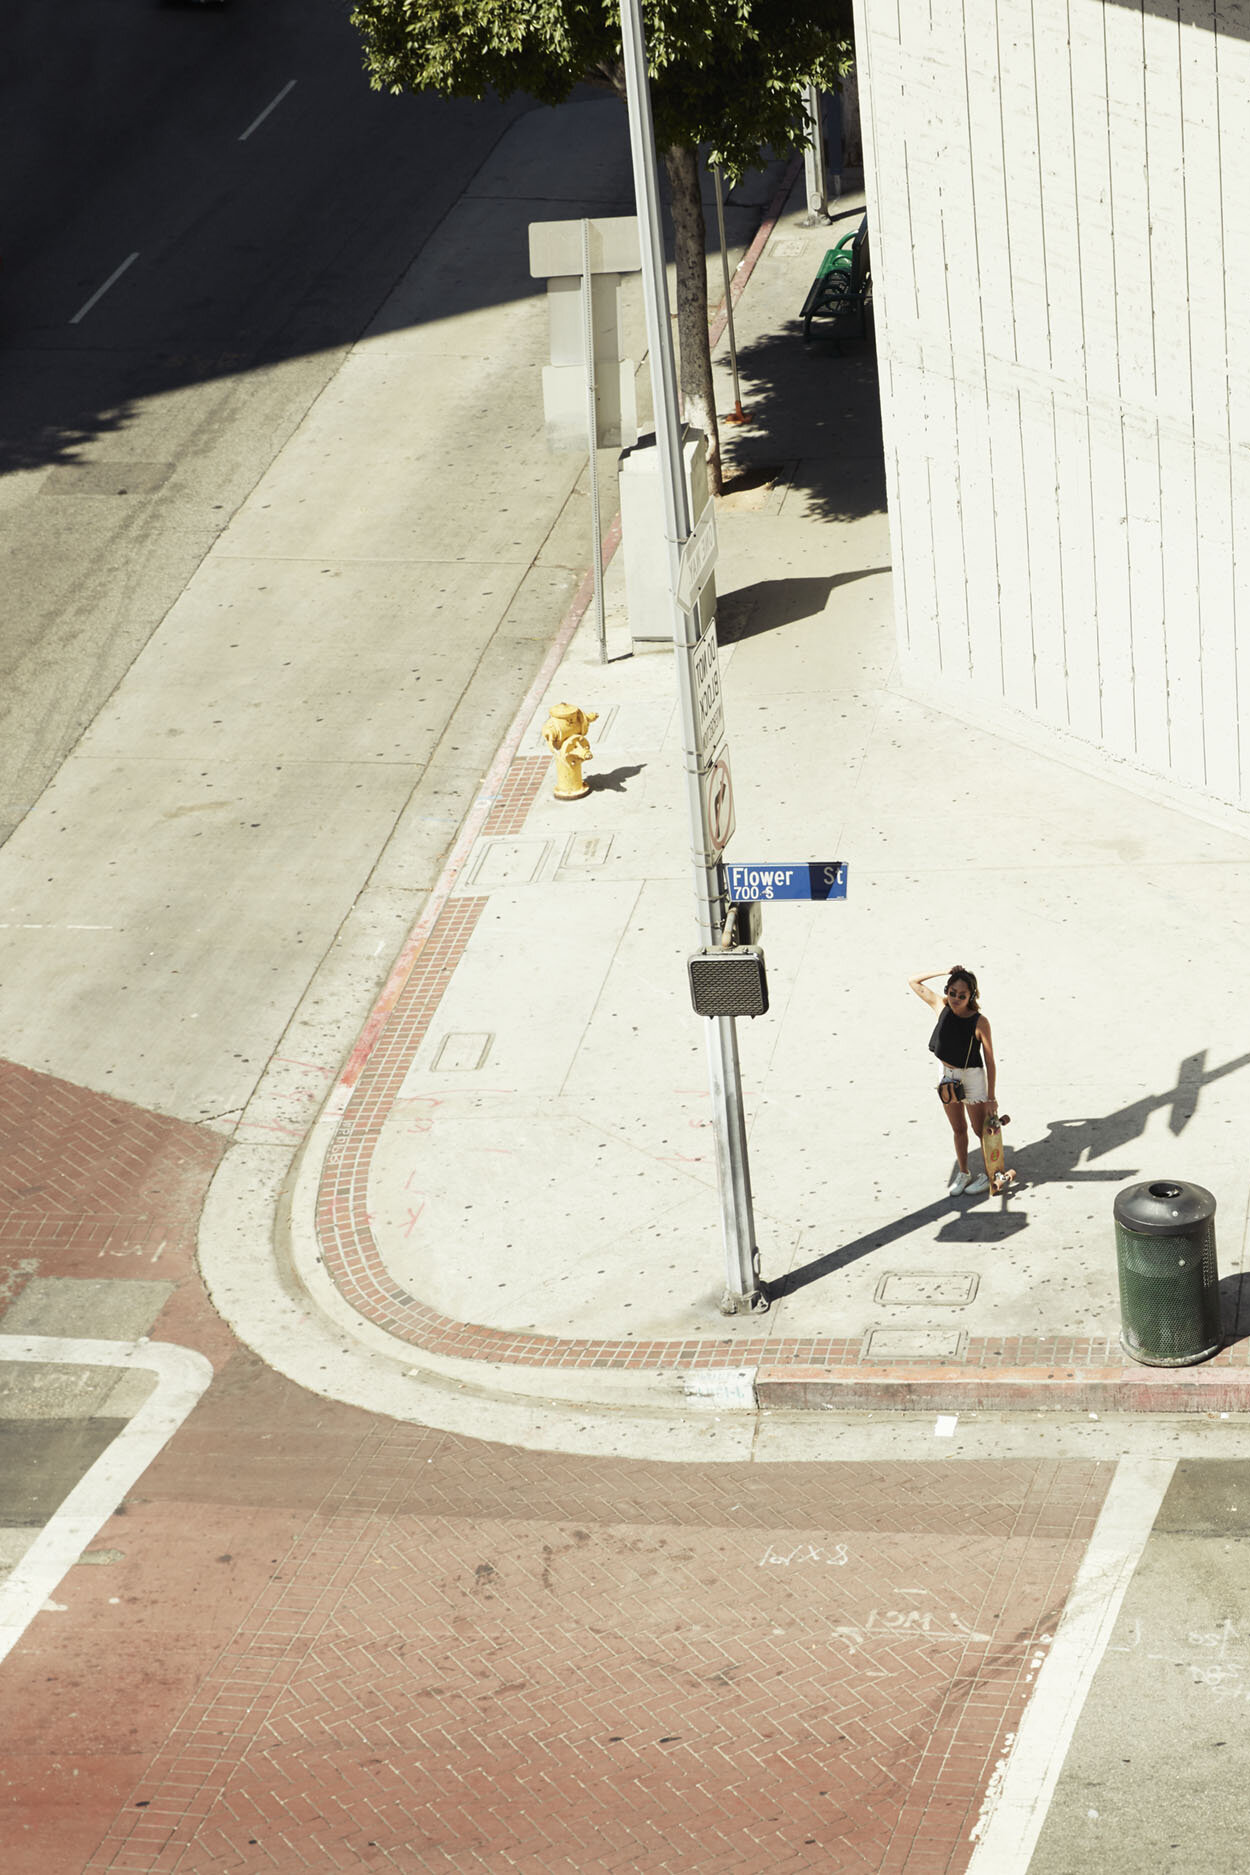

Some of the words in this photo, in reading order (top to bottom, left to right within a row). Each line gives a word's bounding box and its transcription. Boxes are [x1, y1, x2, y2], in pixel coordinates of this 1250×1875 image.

[732, 867, 794, 886] Flower
[823, 866, 844, 885] St
[733, 886, 760, 900] 700
